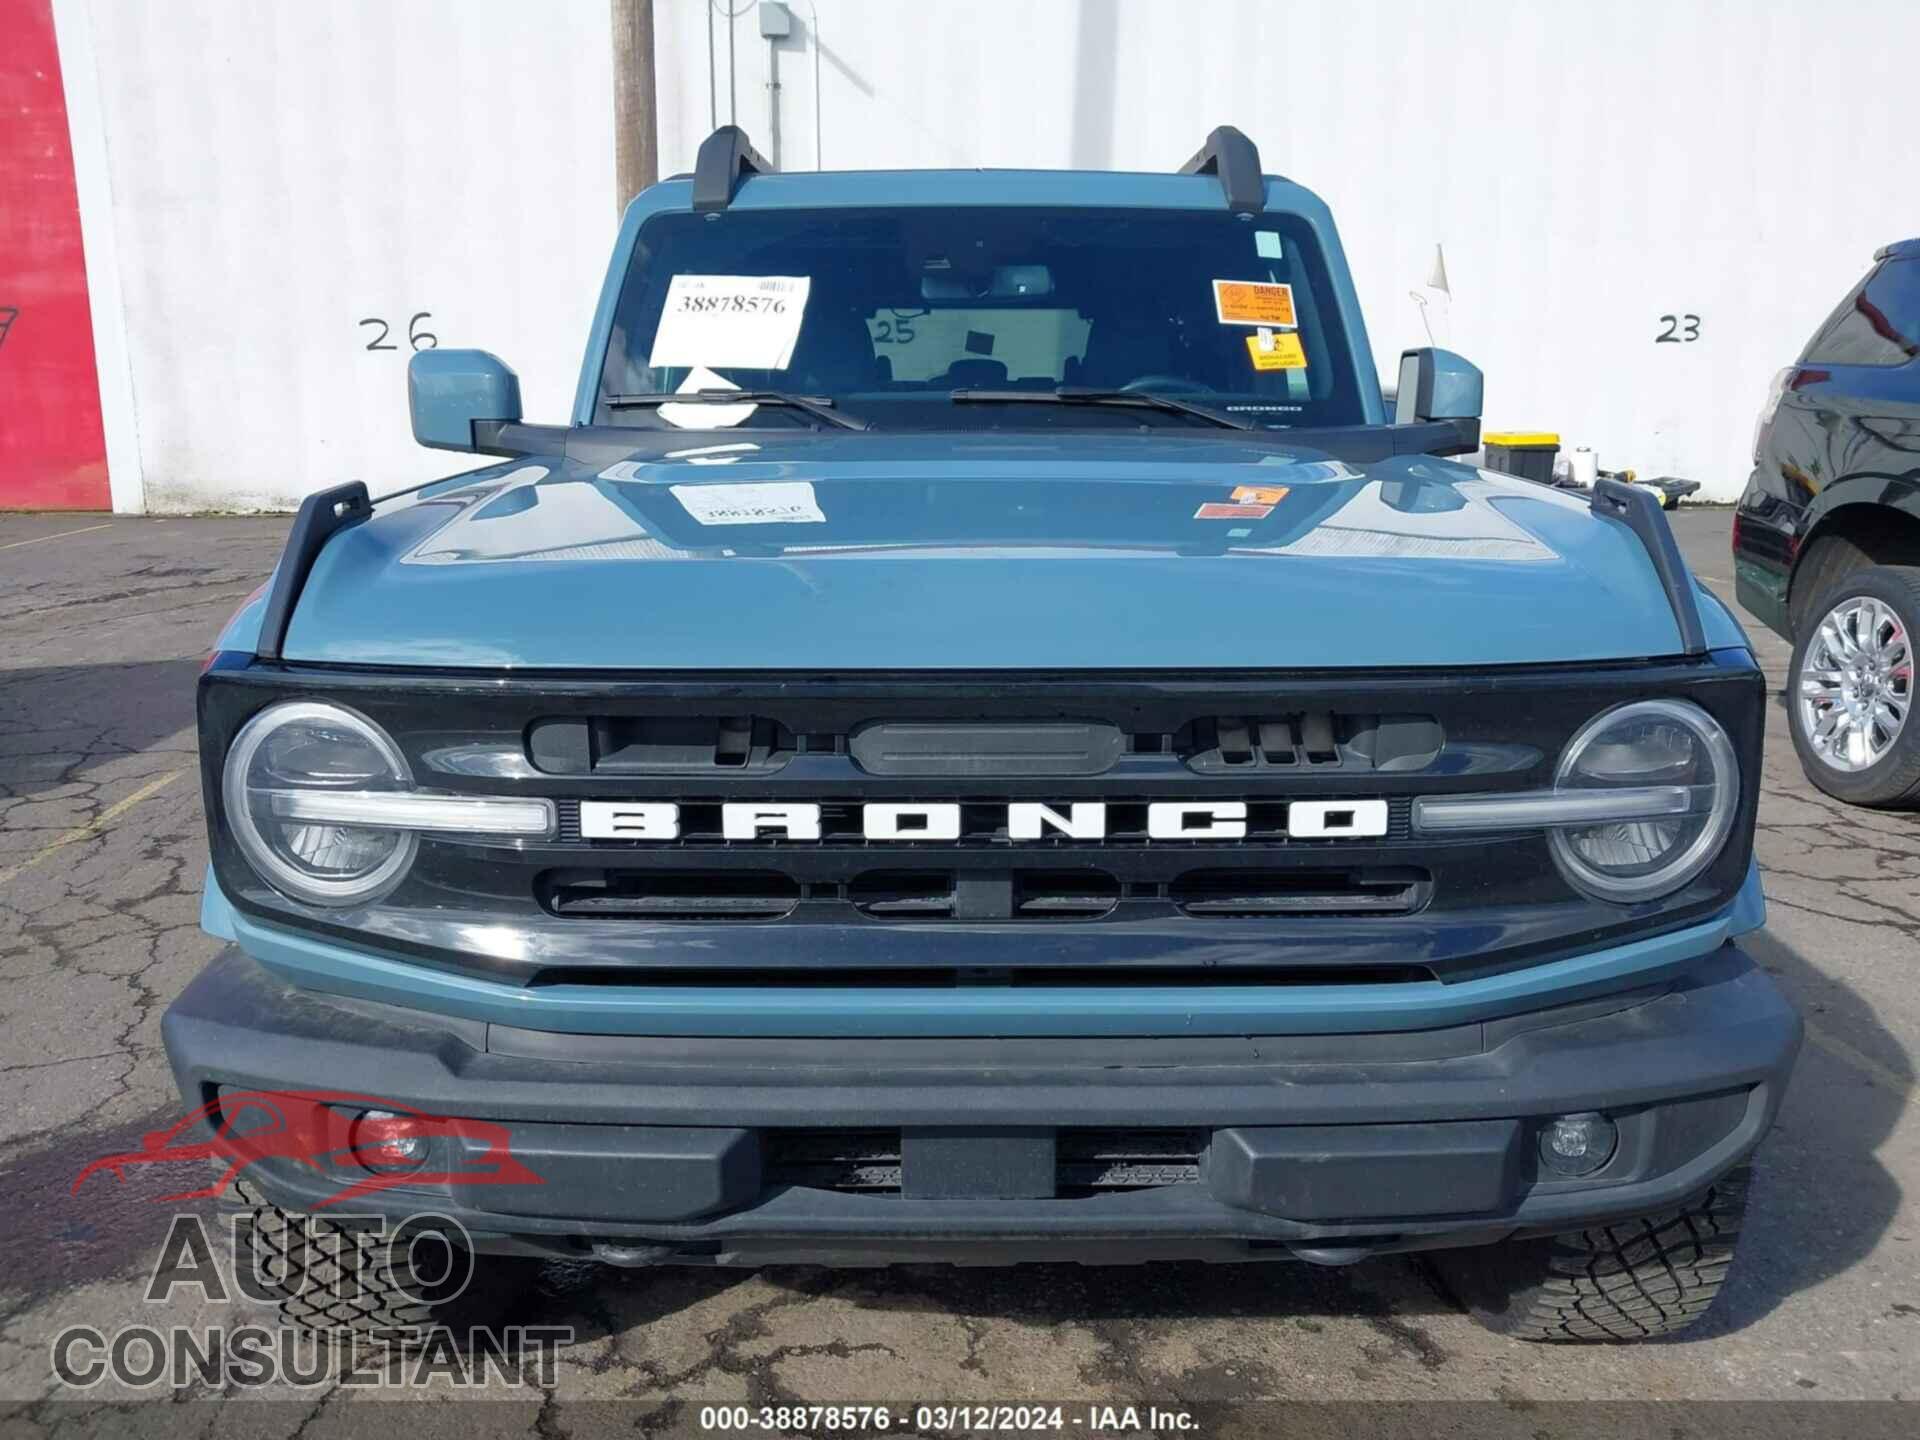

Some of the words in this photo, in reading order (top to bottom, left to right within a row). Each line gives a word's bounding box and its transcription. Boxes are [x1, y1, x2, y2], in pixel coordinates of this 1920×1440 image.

[676, 294, 787, 314] 38878576
[359, 311, 438, 351] 26
[874, 318, 915, 345] 25
[1655, 314, 1701, 343] 23
[580, 801, 1389, 841] BRONCO
